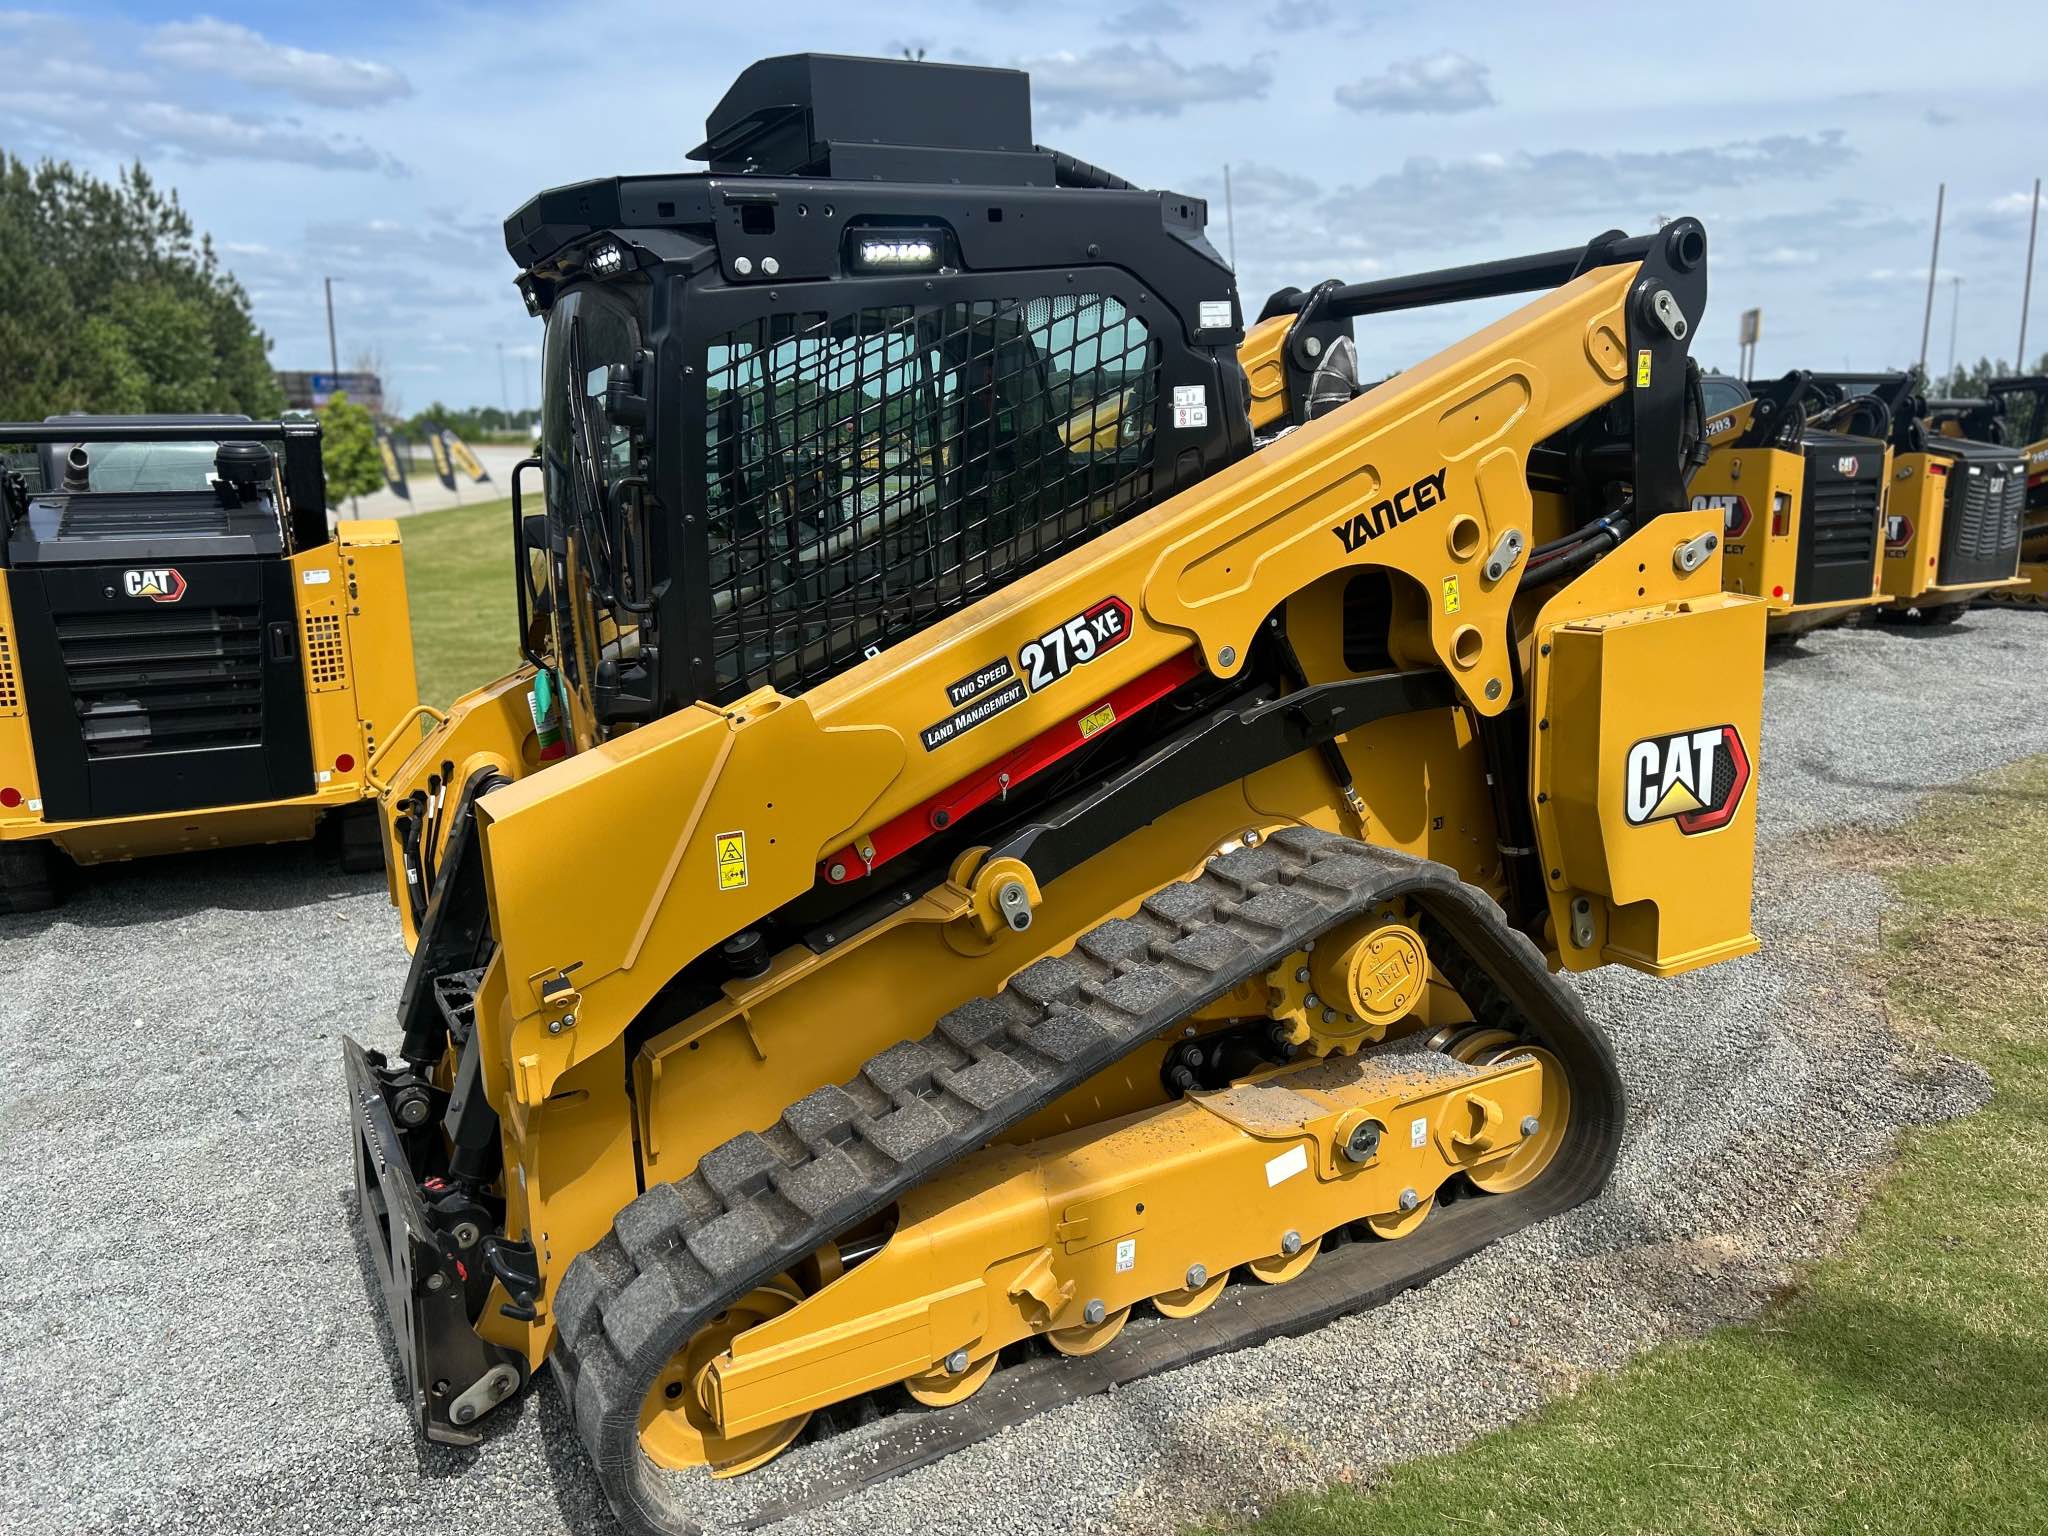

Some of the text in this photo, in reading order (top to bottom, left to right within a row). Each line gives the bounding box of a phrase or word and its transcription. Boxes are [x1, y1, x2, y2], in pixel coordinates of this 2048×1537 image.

[1331, 466, 1447, 554] YANCEY
[1724, 544, 1746, 555] CEY
[125, 570, 170, 595] CAT
[951, 664, 1008, 702] TWO SPEED
[927, 686, 1020, 746] LAND MANAGEMENT
[1627, 728, 1723, 823] CAT
